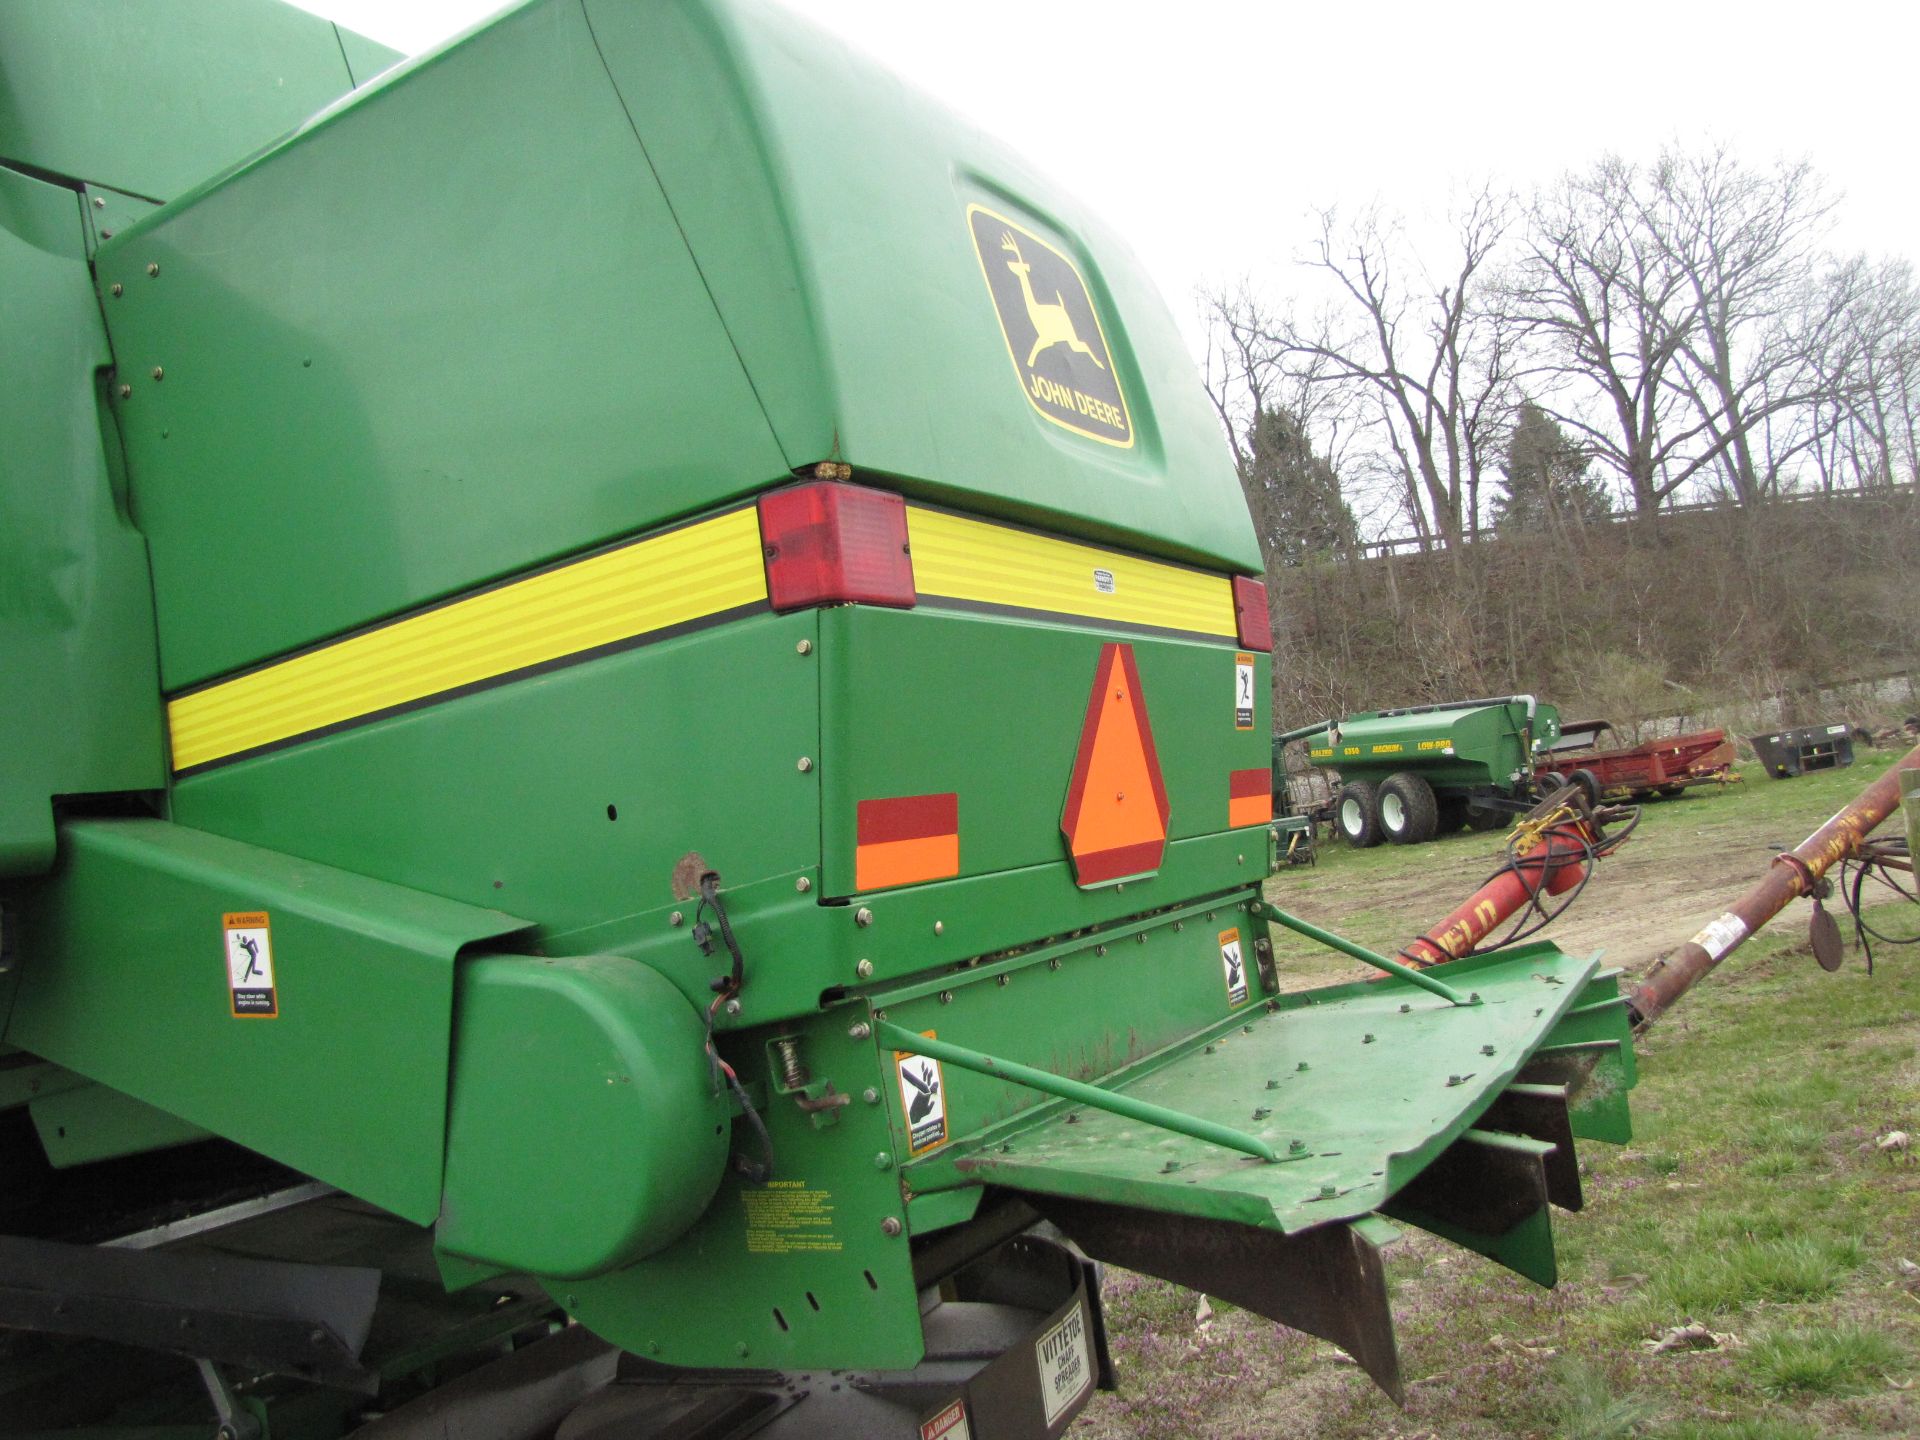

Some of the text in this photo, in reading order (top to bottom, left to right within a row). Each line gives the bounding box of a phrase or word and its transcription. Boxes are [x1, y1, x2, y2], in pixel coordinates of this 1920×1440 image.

[1031, 373, 1125, 430] JOHN DEERE
[236, 916, 265, 924] WARNING
[767, 1181, 805, 1189] IMPORTANT
[1042, 1313, 1081, 1364] VITTETOE
[1057, 1344, 1075, 1370] CHAFF
[1054, 1354, 1081, 1391] SPREADER
[934, 1406, 961, 1434] DANGER
